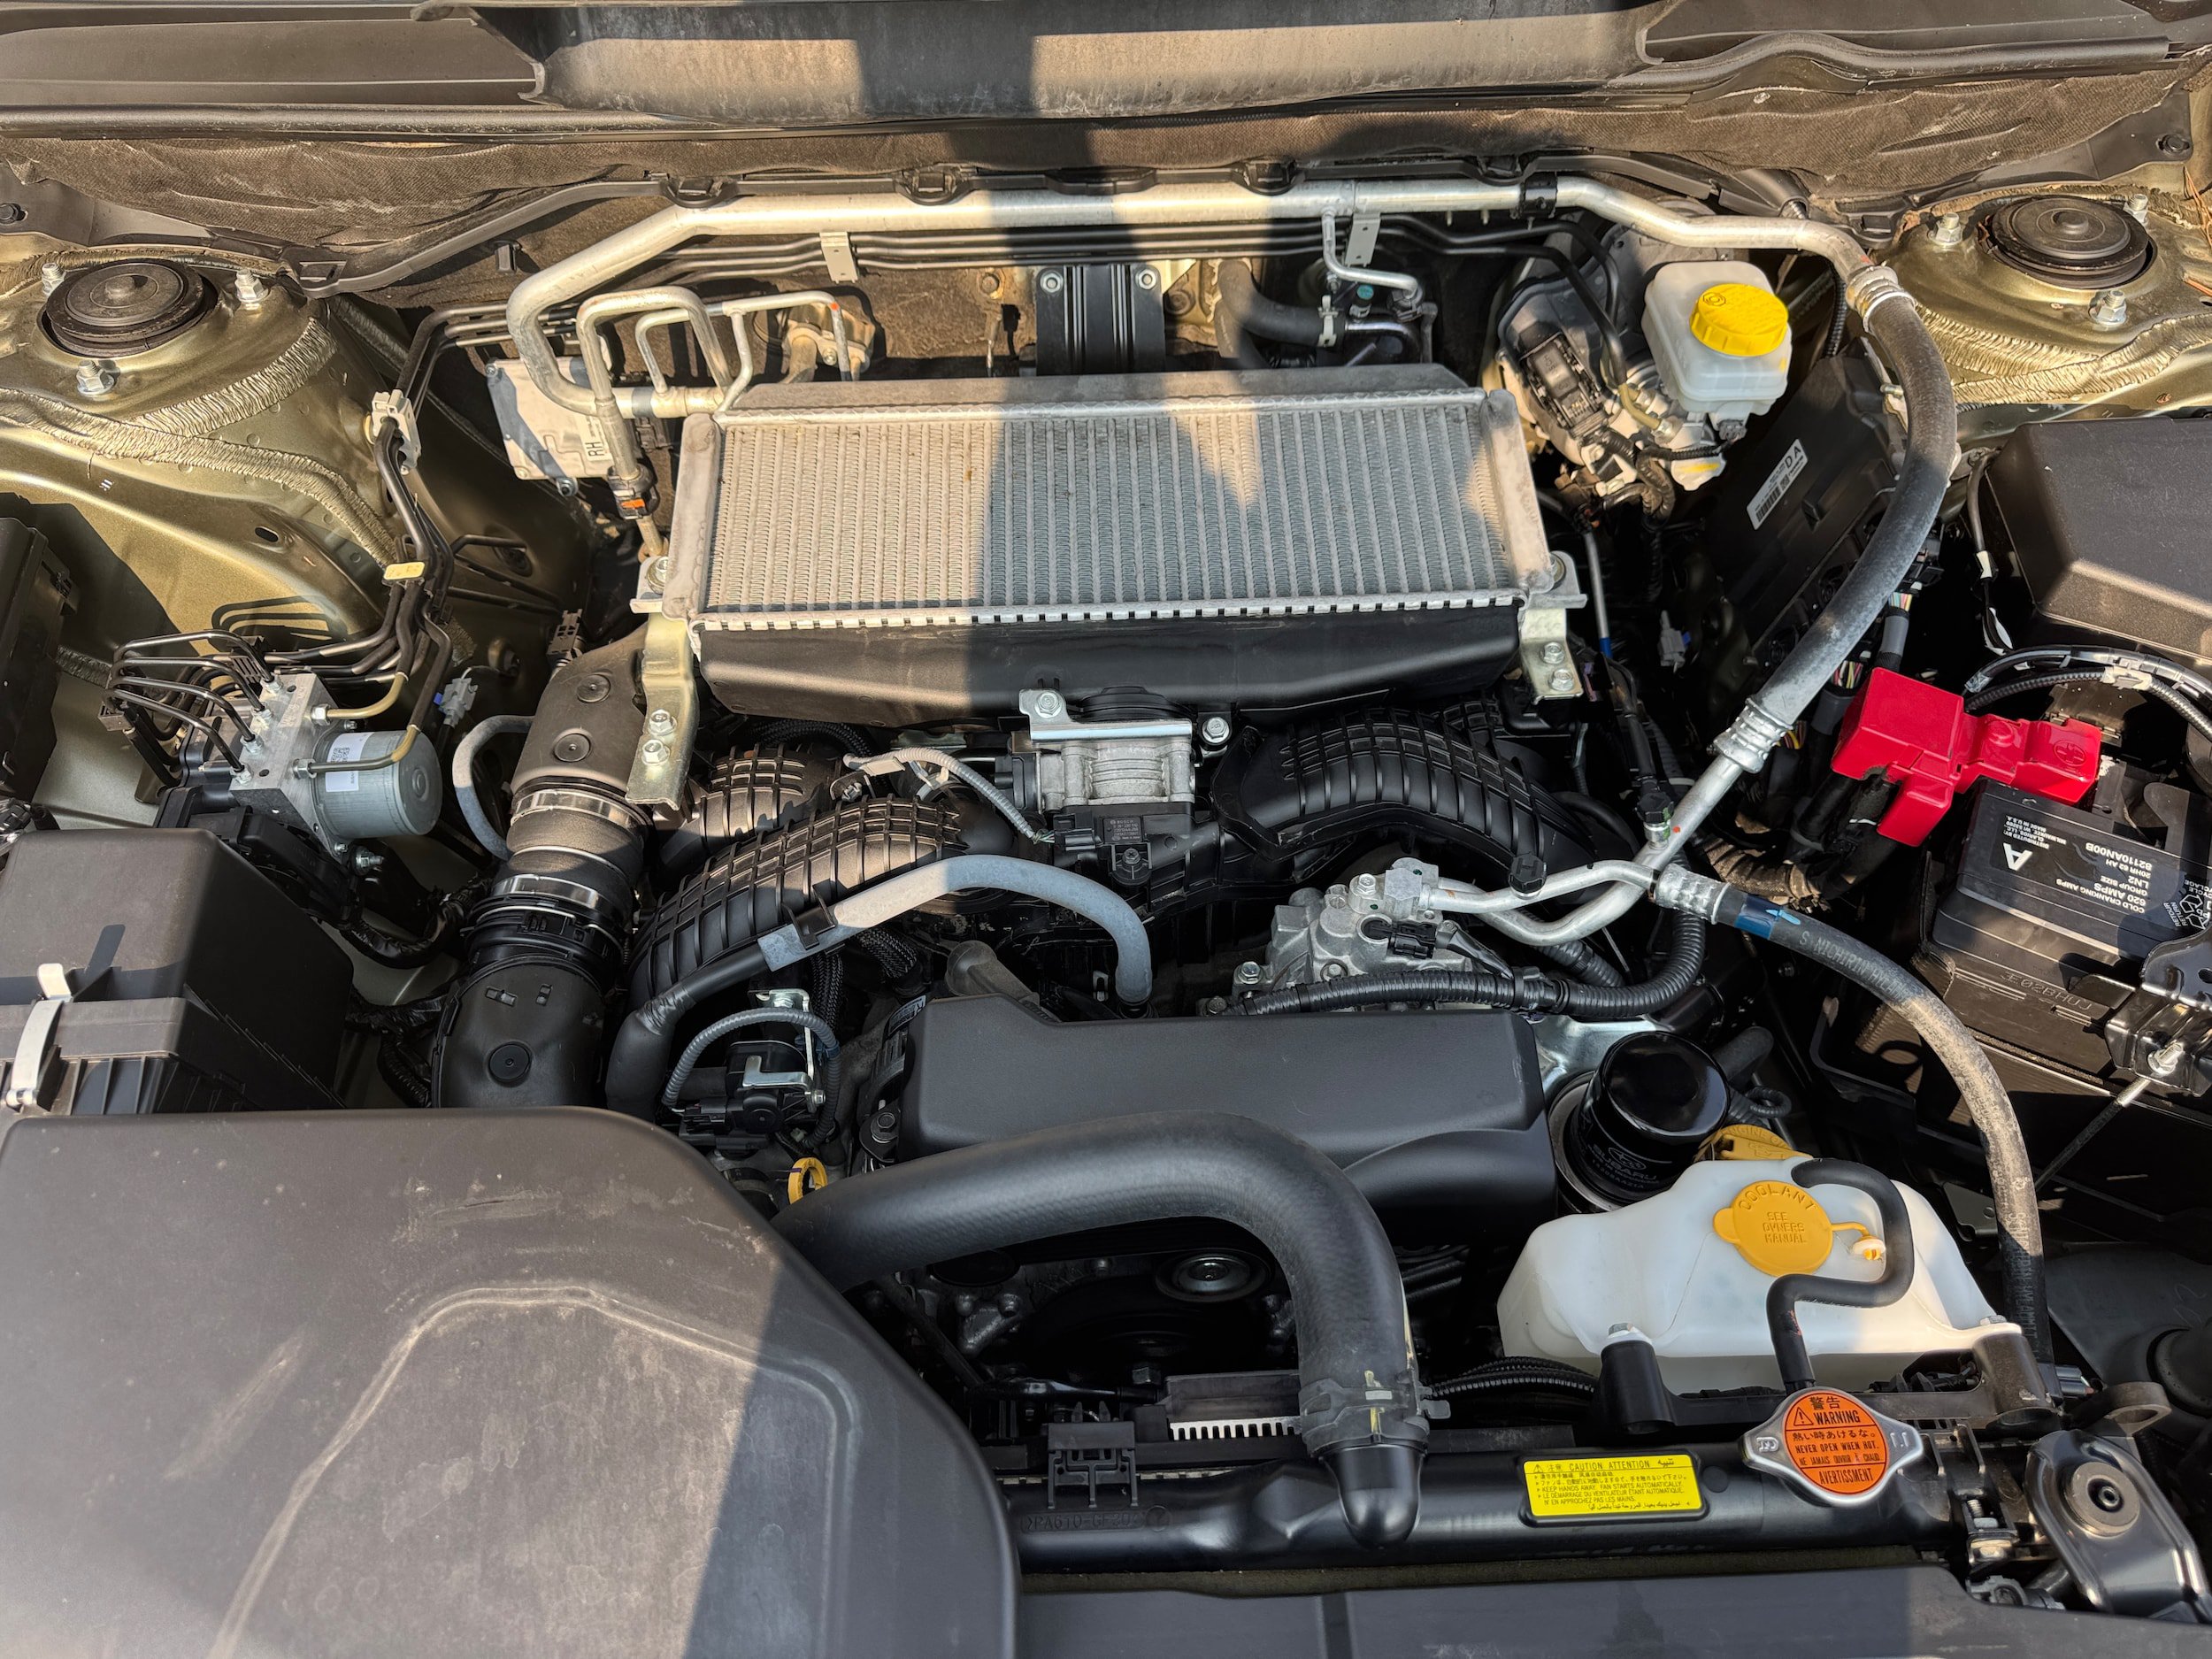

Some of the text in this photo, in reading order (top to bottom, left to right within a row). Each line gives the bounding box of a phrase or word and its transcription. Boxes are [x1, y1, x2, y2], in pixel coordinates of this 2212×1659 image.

[585, 442, 606, 457] RH
[2012, 833, 2050, 849] DISTRIBUTED
[2085, 842, 2153, 871] 82110AN00B
[2105, 858, 2151, 879] 20HR 62 AH
[2100, 875, 2148, 896] GROUP SIZE
[2127, 875, 2149, 889] LN2
[2055, 878, 2145, 914] COLD CRANKING AMPS
[2093, 882, 2147, 907] 620 AMPS
[2162, 902, 2182, 927] RETOUR
[2170, 902, 2188, 926] RETURN
[1738, 1183, 1817, 1210] COOLANT
[1766, 1211, 1788, 1221] SEE
[1764, 1233, 1807, 1244] MANUAL
[1809, 1396, 1841, 1410] 警告
[1813, 1409, 1861, 1425] WARNING
[1792, 1428, 1877, 1441] 熱い時あけるな。
[1794, 1440, 1880, 1454] NEVER OPEN WHEN HOT.
[1569, 1460, 1650, 1471] CAUTION ATTENTION
[1799, 1456, 1808, 1466] NE
[1810, 1455, 1831, 1465] JAMAIS
[1818, 1467, 1874, 1486] AVERTISSMENT
